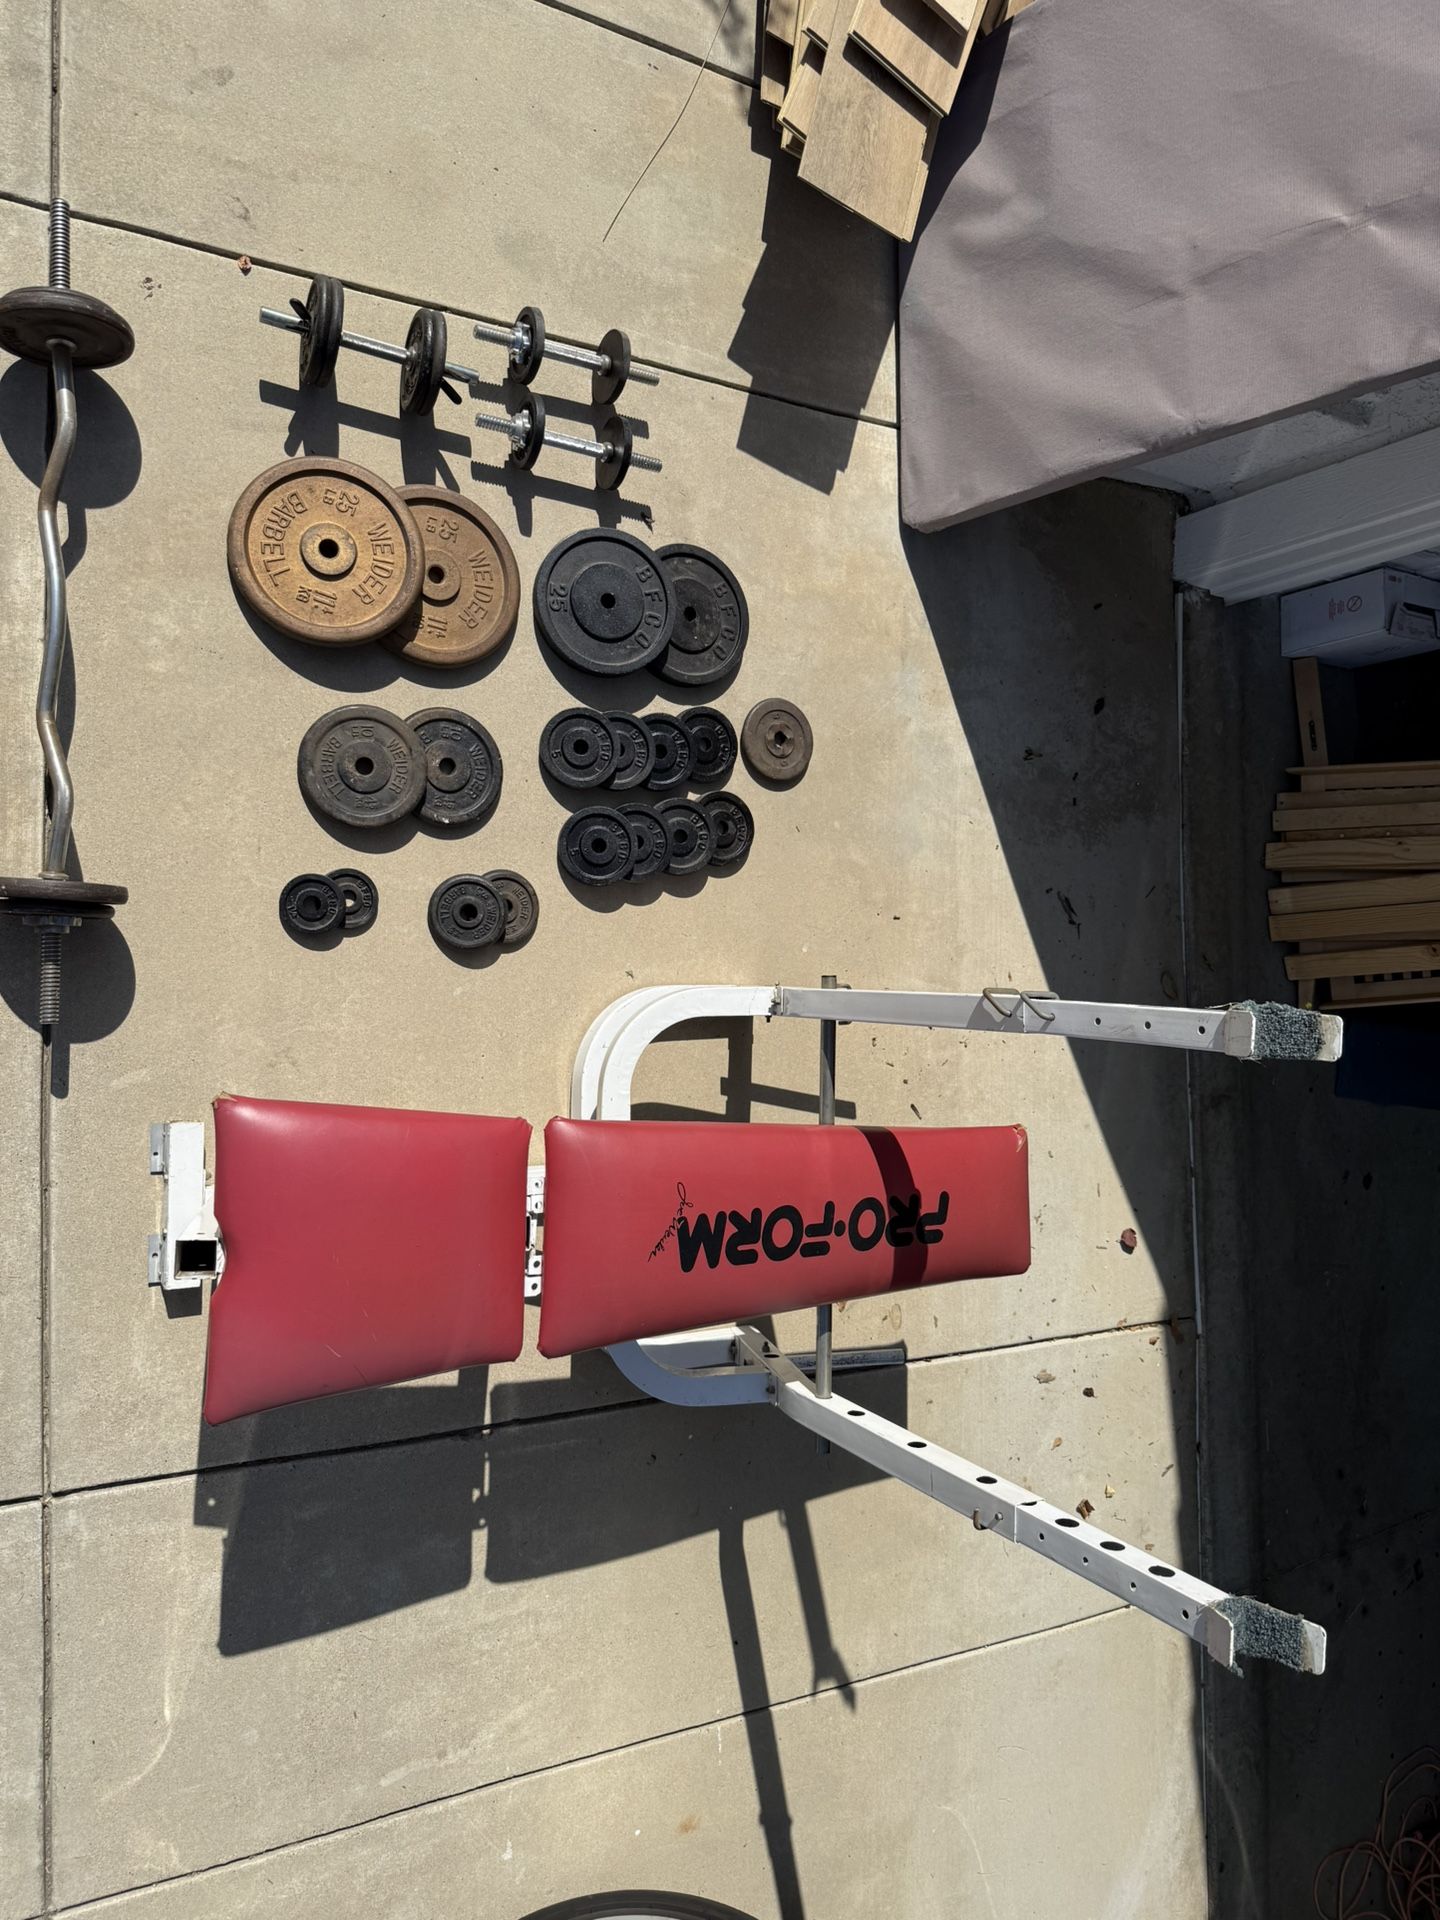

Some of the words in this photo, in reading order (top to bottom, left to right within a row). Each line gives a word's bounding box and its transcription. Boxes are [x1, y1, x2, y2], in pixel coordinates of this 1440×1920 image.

[322, 488, 337, 506] LB
[335, 490, 360, 517] 25
[260, 489, 308, 588] BARBELL
[425, 516, 438, 534] LB
[439, 519, 460, 543] 25
[352, 522, 395, 605] WEIDER
[458, 550, 494, 629] WEIDER
[549, 584, 569, 613] 25
[634, 564, 663, 650] BFCO
[711, 582, 737, 661] BFCO
[360, 726, 375, 738] 10
[450, 727, 462, 741] 10
[321, 736, 345, 801] BARBELL
[387, 738, 408, 795] WEIDER
[465, 743, 488, 800] WEIDER
[472, 905, 498, 940] WEIDER
